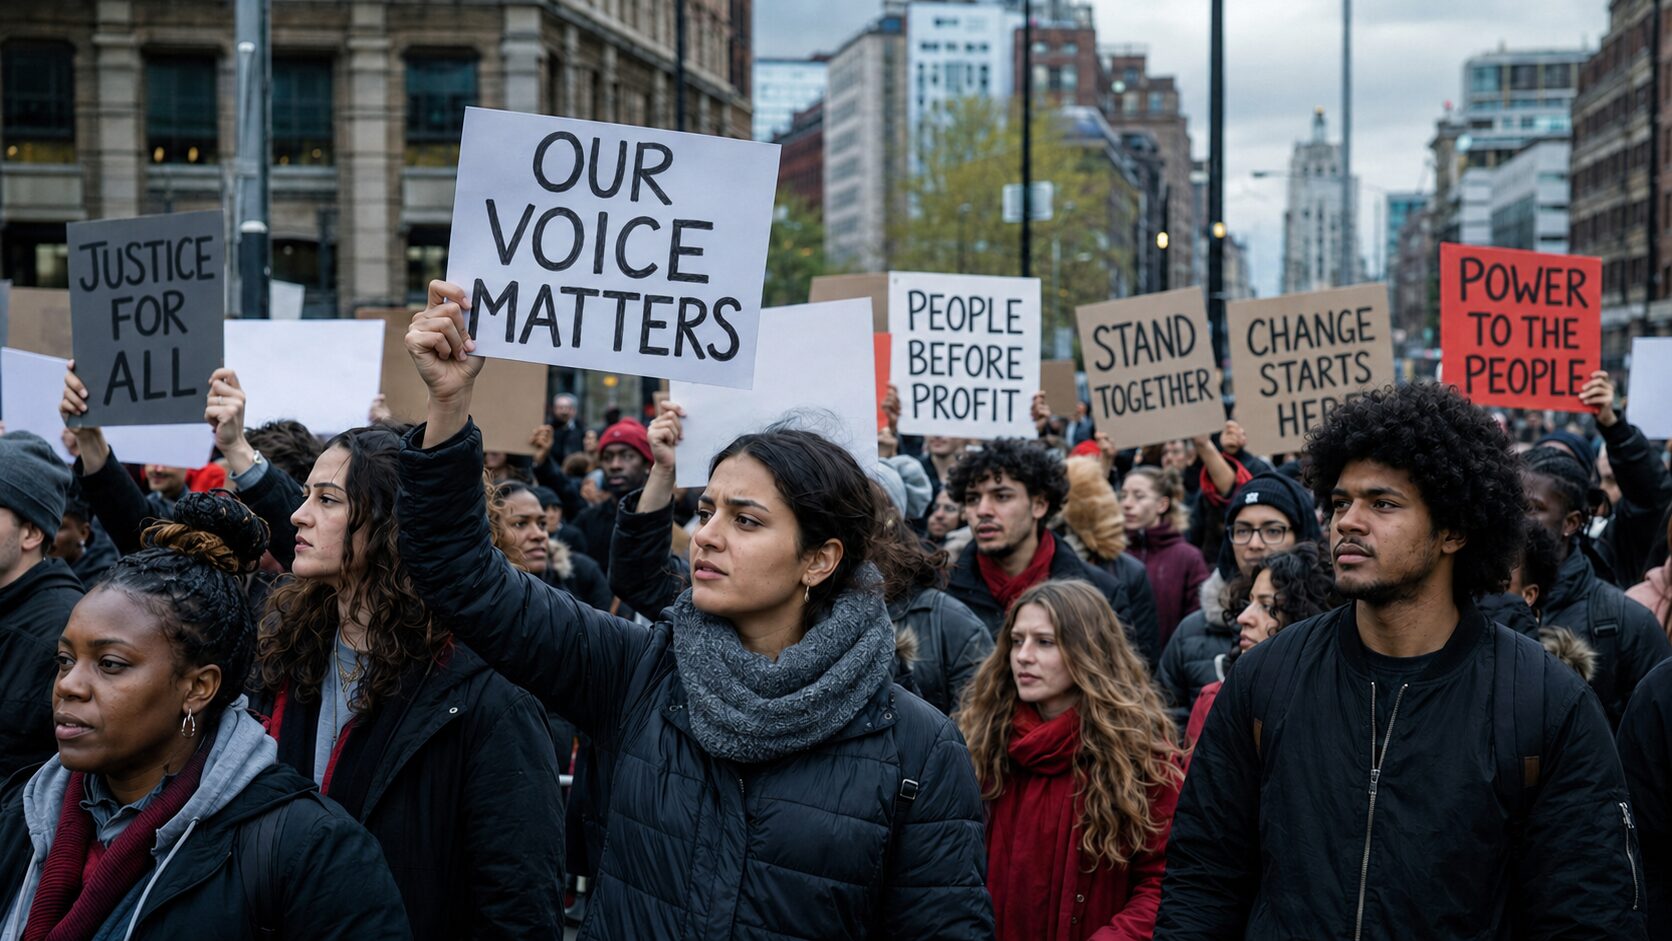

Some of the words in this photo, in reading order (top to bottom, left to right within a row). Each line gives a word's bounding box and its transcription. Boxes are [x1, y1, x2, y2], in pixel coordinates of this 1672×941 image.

[533, 131, 673, 206] OUR
[78, 235, 215, 292] JUSTICE
[485, 198, 714, 284] VOICE
[1460, 257, 1589, 309] POWER
[111, 290, 188, 341] FOR
[468, 278, 742, 362] MATTERS
[908, 290, 1024, 335] PEOPLE
[1247, 306, 1375, 357] CHANGE
[1467, 312, 1512, 347] TO
[1521, 315, 1581, 350] THE
[908, 339, 1024, 380] BEFORE
[1093, 314, 1196, 372] STAND
[103, 347, 197, 406] ALL
[1094, 368, 1214, 419] TOGETHER
[1260, 351, 1372, 397] STARTS
[1465, 354, 1586, 396] PEOPLE
[912, 383, 1021, 422] PROFIT
